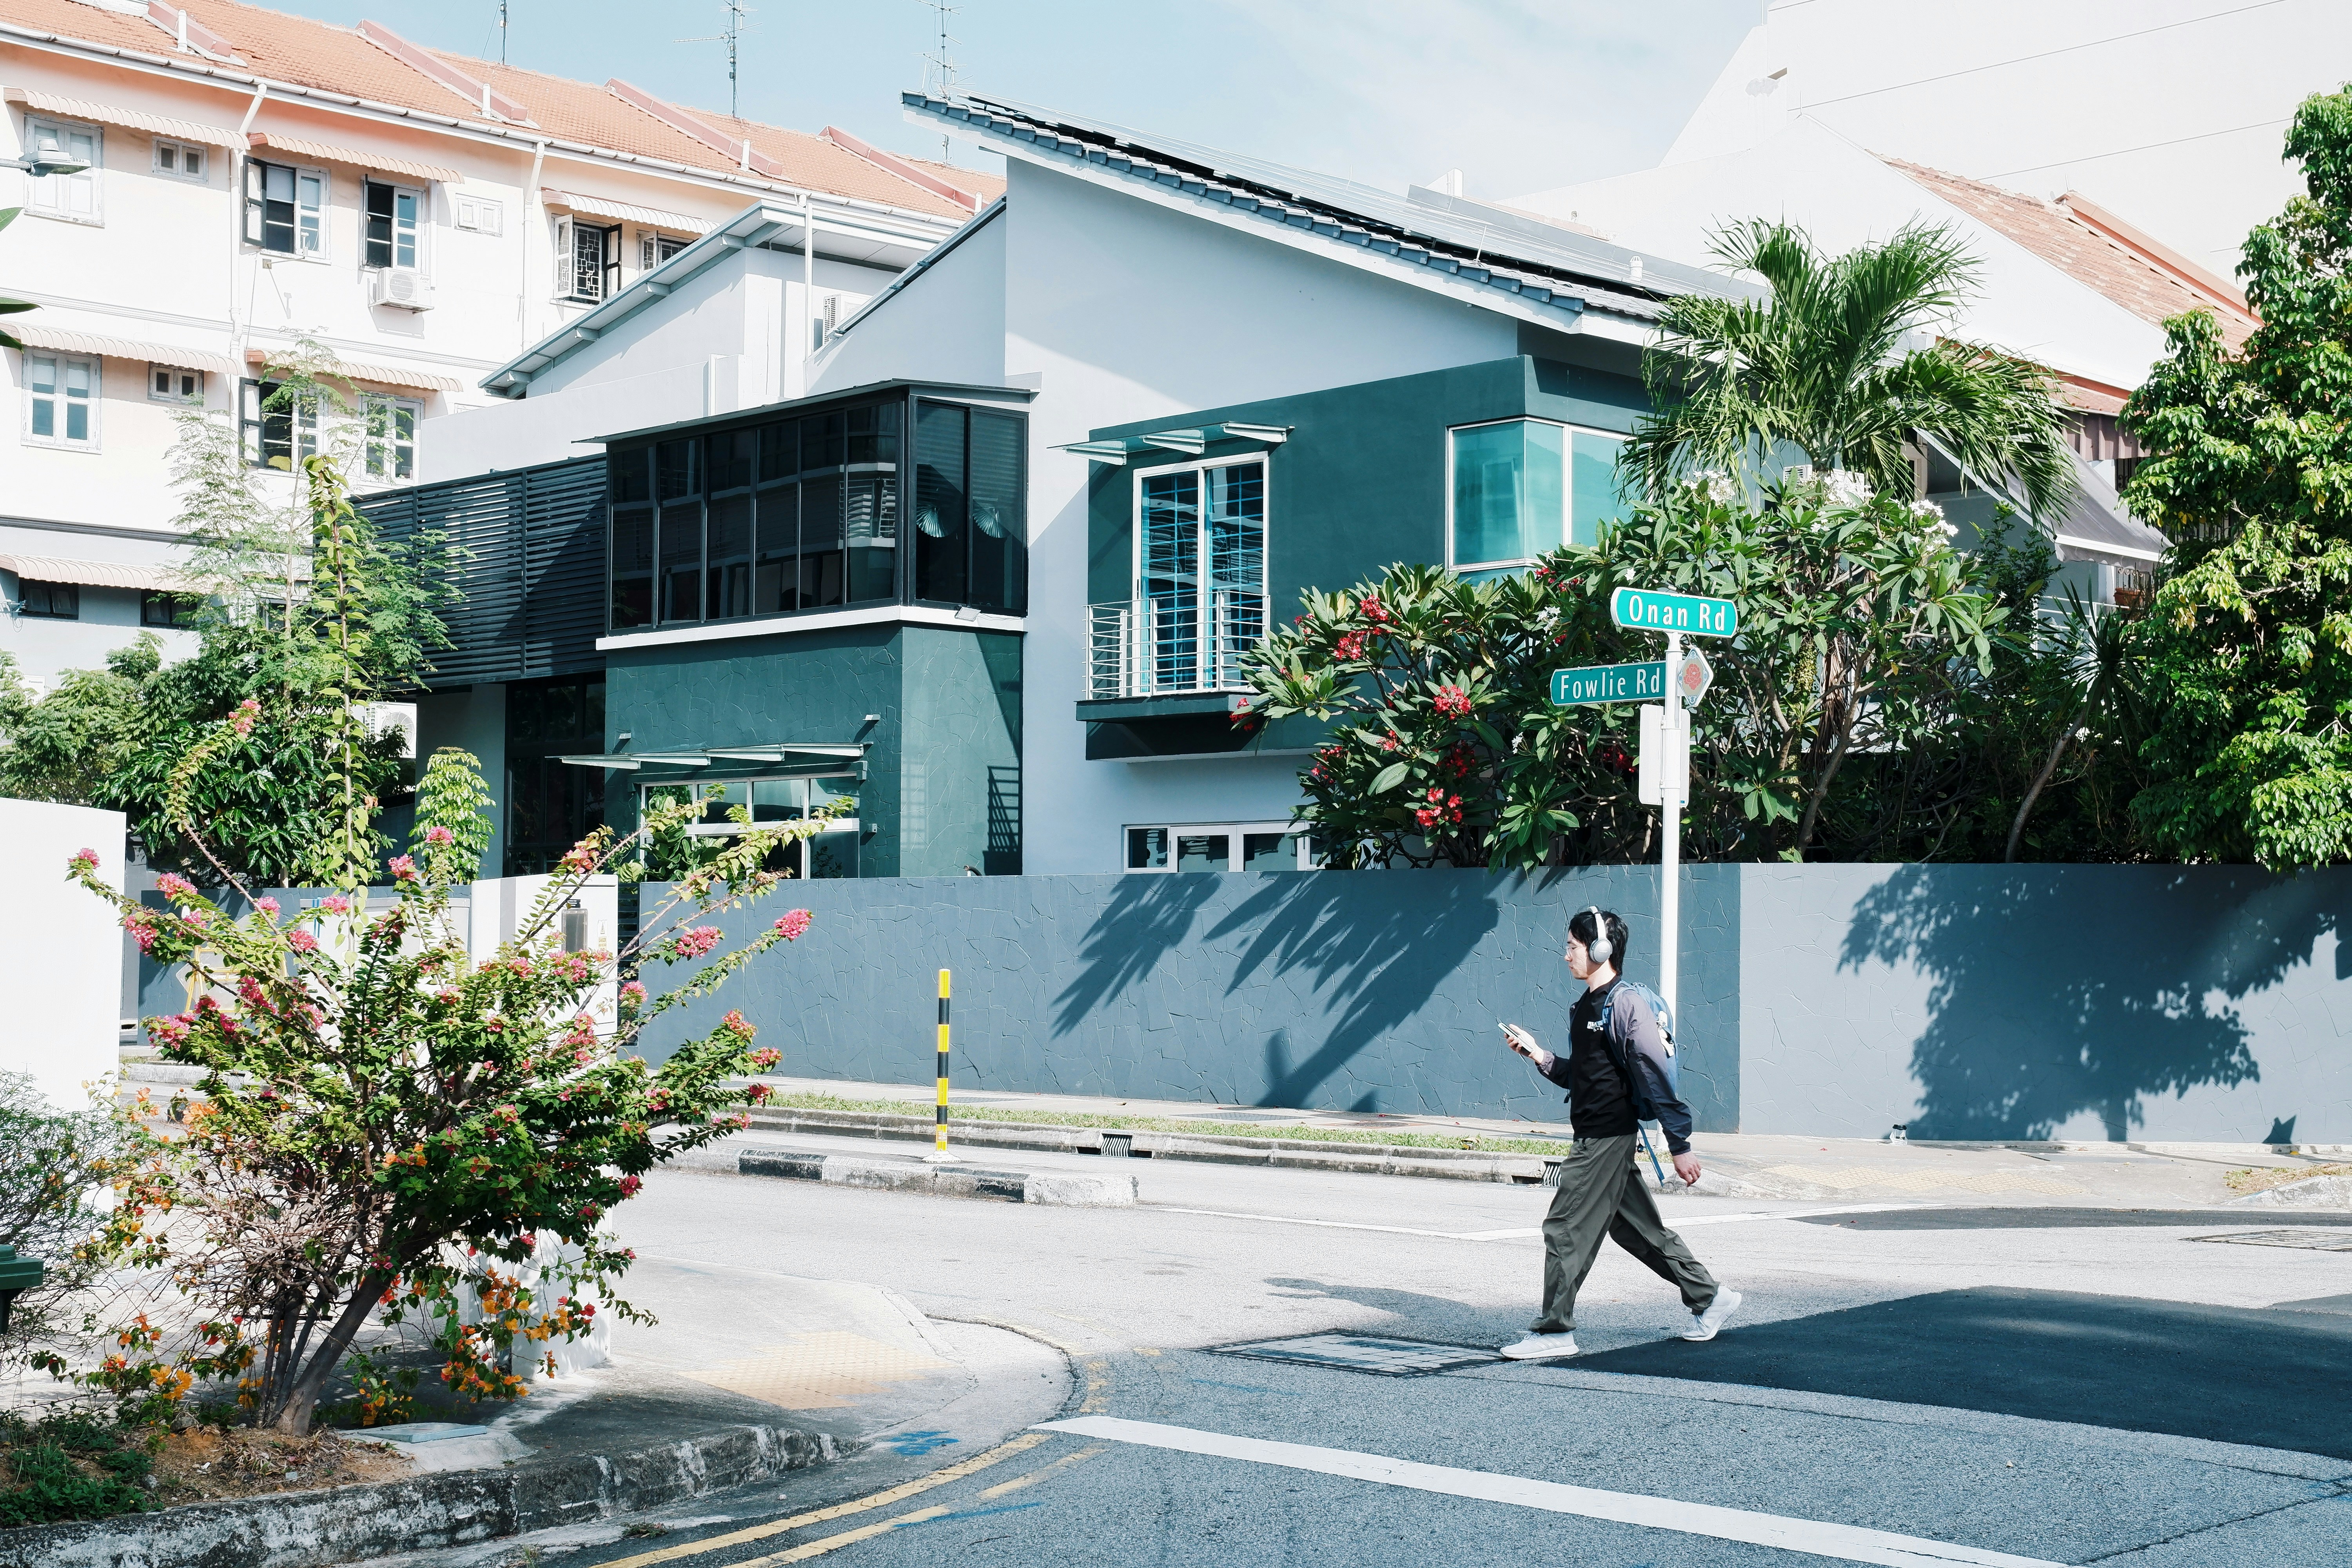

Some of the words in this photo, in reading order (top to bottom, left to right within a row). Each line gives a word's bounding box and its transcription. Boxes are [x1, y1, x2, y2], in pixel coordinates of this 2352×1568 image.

[1629, 595, 1688, 627] Onan
[1699, 603, 1725, 631] Rd
[1561, 671, 1626, 700] Fowlie
[1636, 667, 1660, 694] Rd
